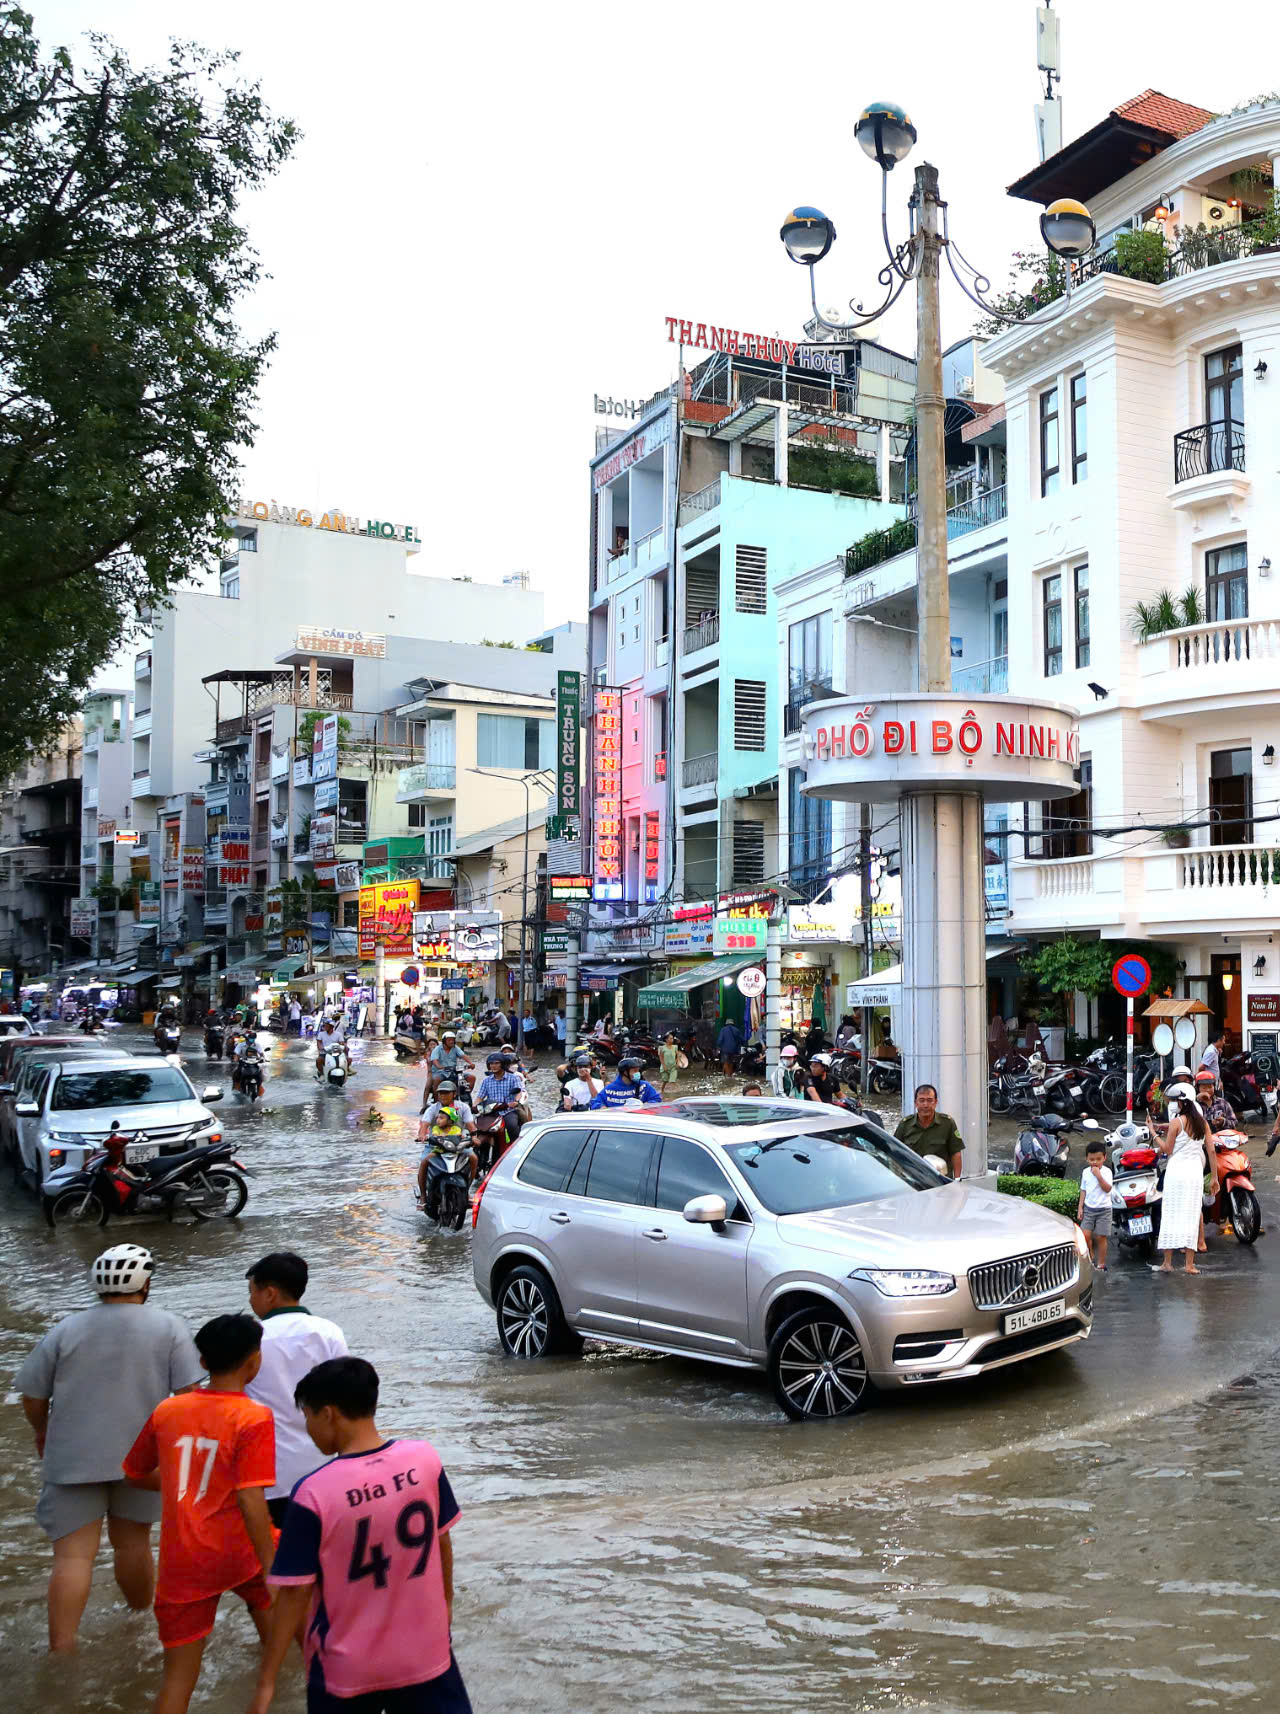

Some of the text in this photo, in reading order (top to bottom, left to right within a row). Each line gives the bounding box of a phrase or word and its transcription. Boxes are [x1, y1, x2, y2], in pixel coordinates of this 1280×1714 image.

[800, 346, 845, 376] Hotel
[319, 511, 360, 534] ANH
[367, 519, 422, 543] HOTEL
[562, 704, 576, 767] TRUNG
[816, 704, 873, 757] PHỐ
[883, 720, 917, 754] ĐI
[932, 709, 982, 766] BỘ
[996, 721, 1060, 759] NINH
[1010, 1304, 1061, 1330] 51L-480.65
[174, 1434, 219, 1505] 17
[392, 1467, 419, 1493] FC
[346, 1499, 435, 1590] 49
